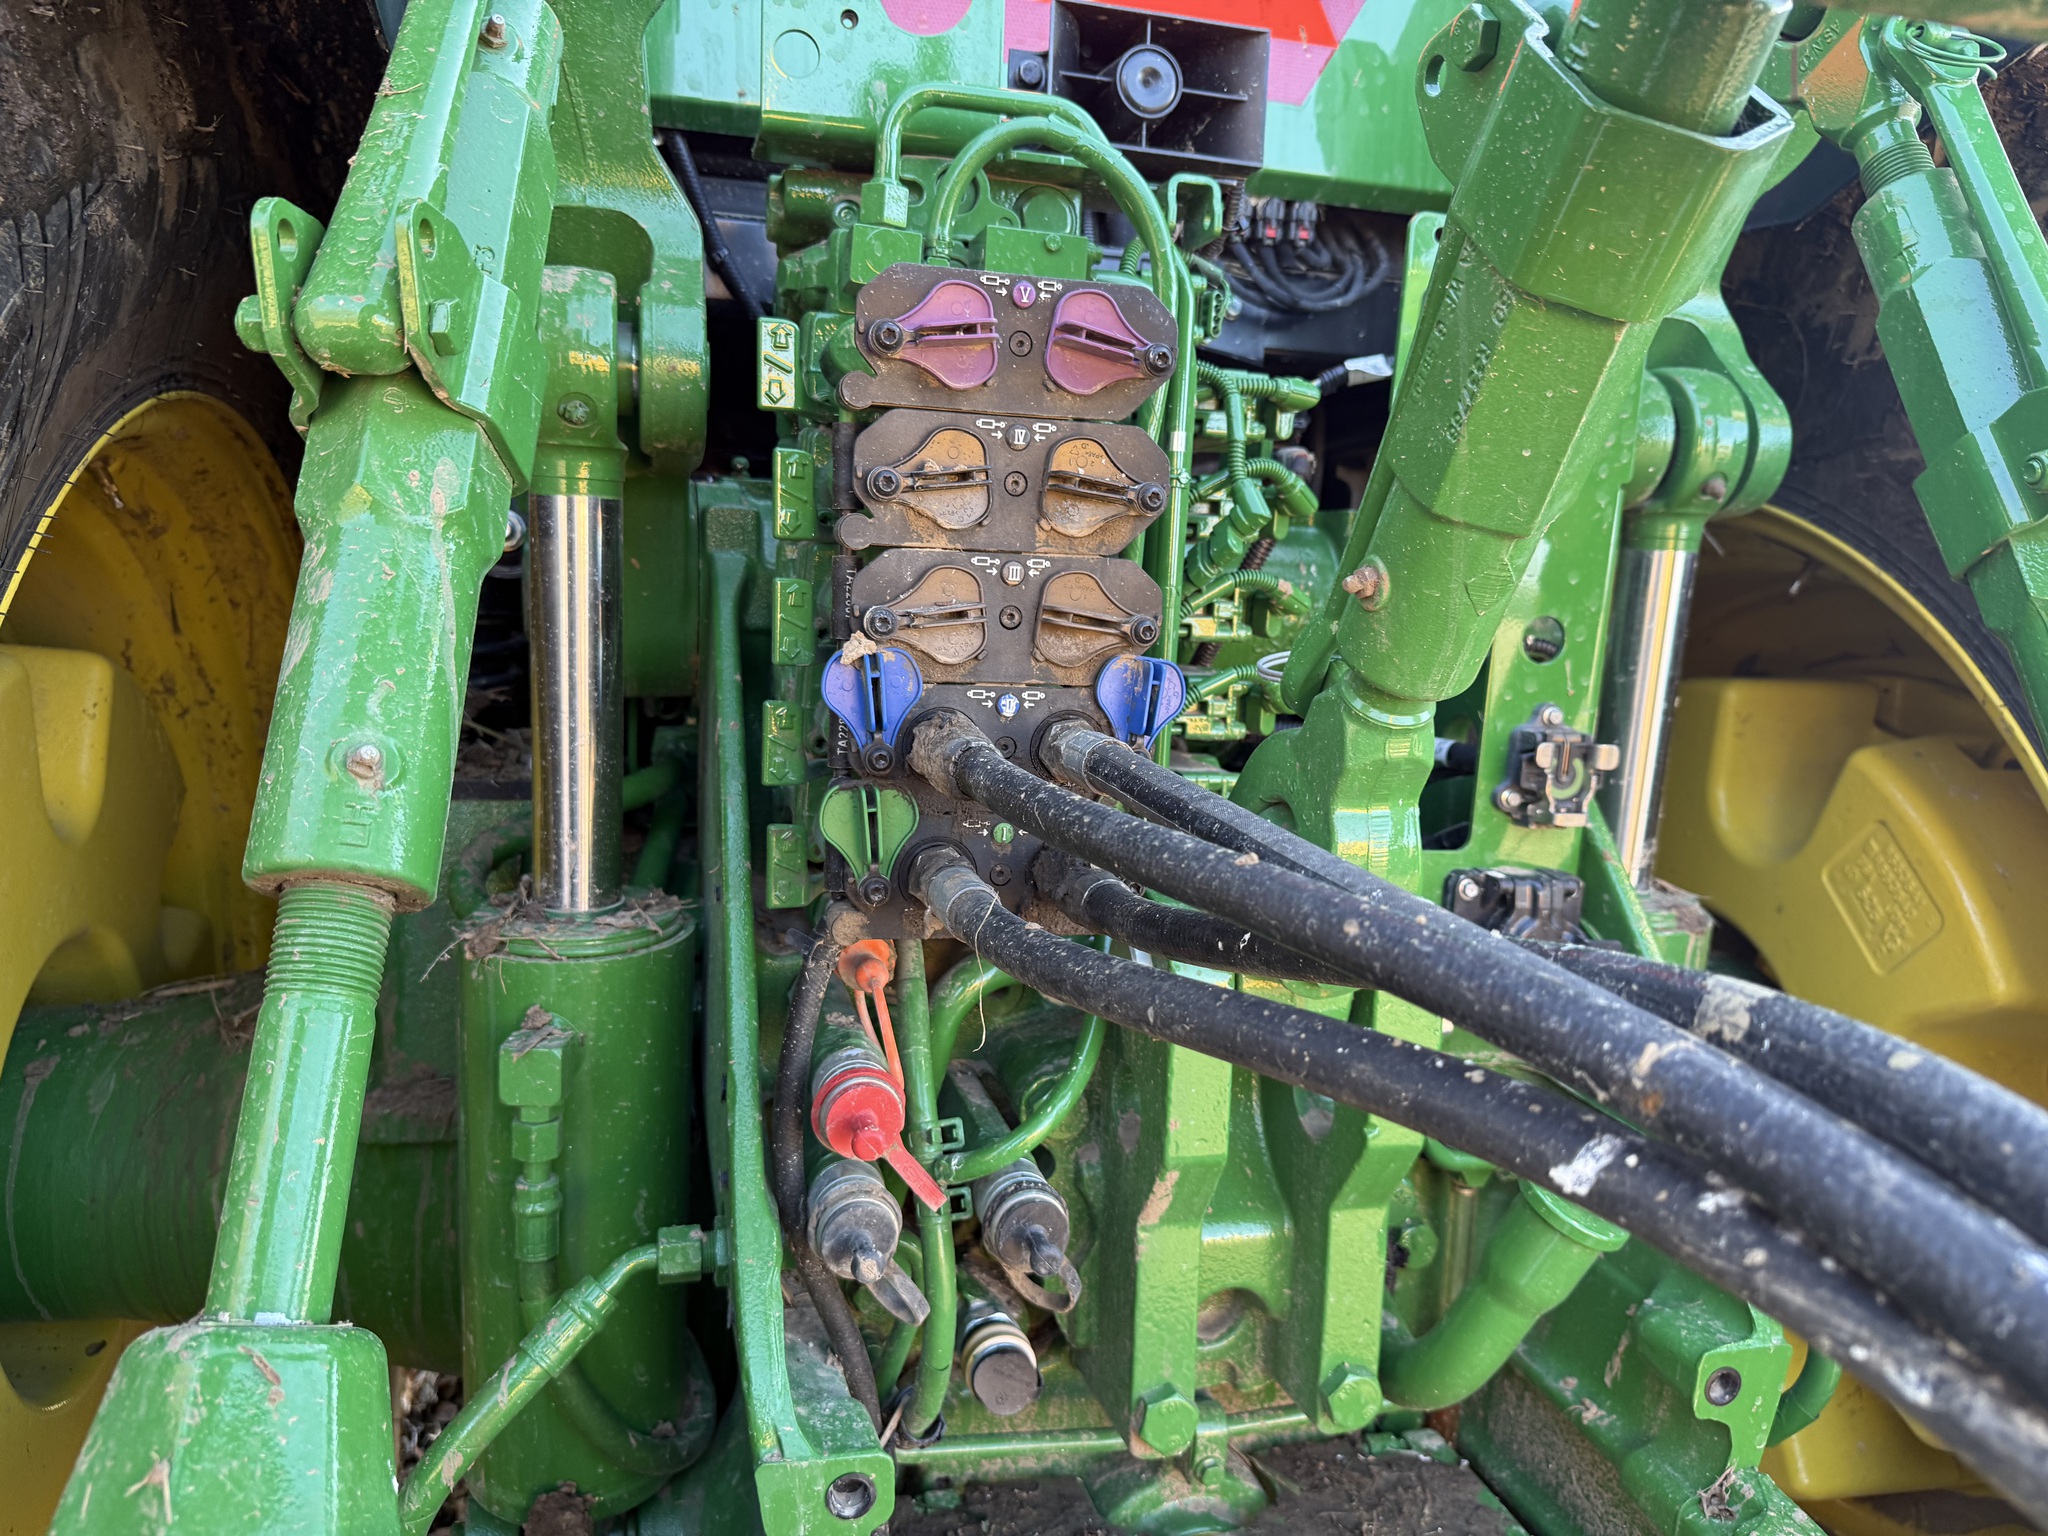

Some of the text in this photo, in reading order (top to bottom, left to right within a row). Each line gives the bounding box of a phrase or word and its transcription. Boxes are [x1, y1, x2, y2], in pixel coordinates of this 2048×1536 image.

[1019, 286, 1032, 303] V
[1013, 428, 1027, 445] IV
[1007, 565, 1022, 581] III
[1004, 698, 1017, 713] II
[1001, 826, 1008, 841] I
